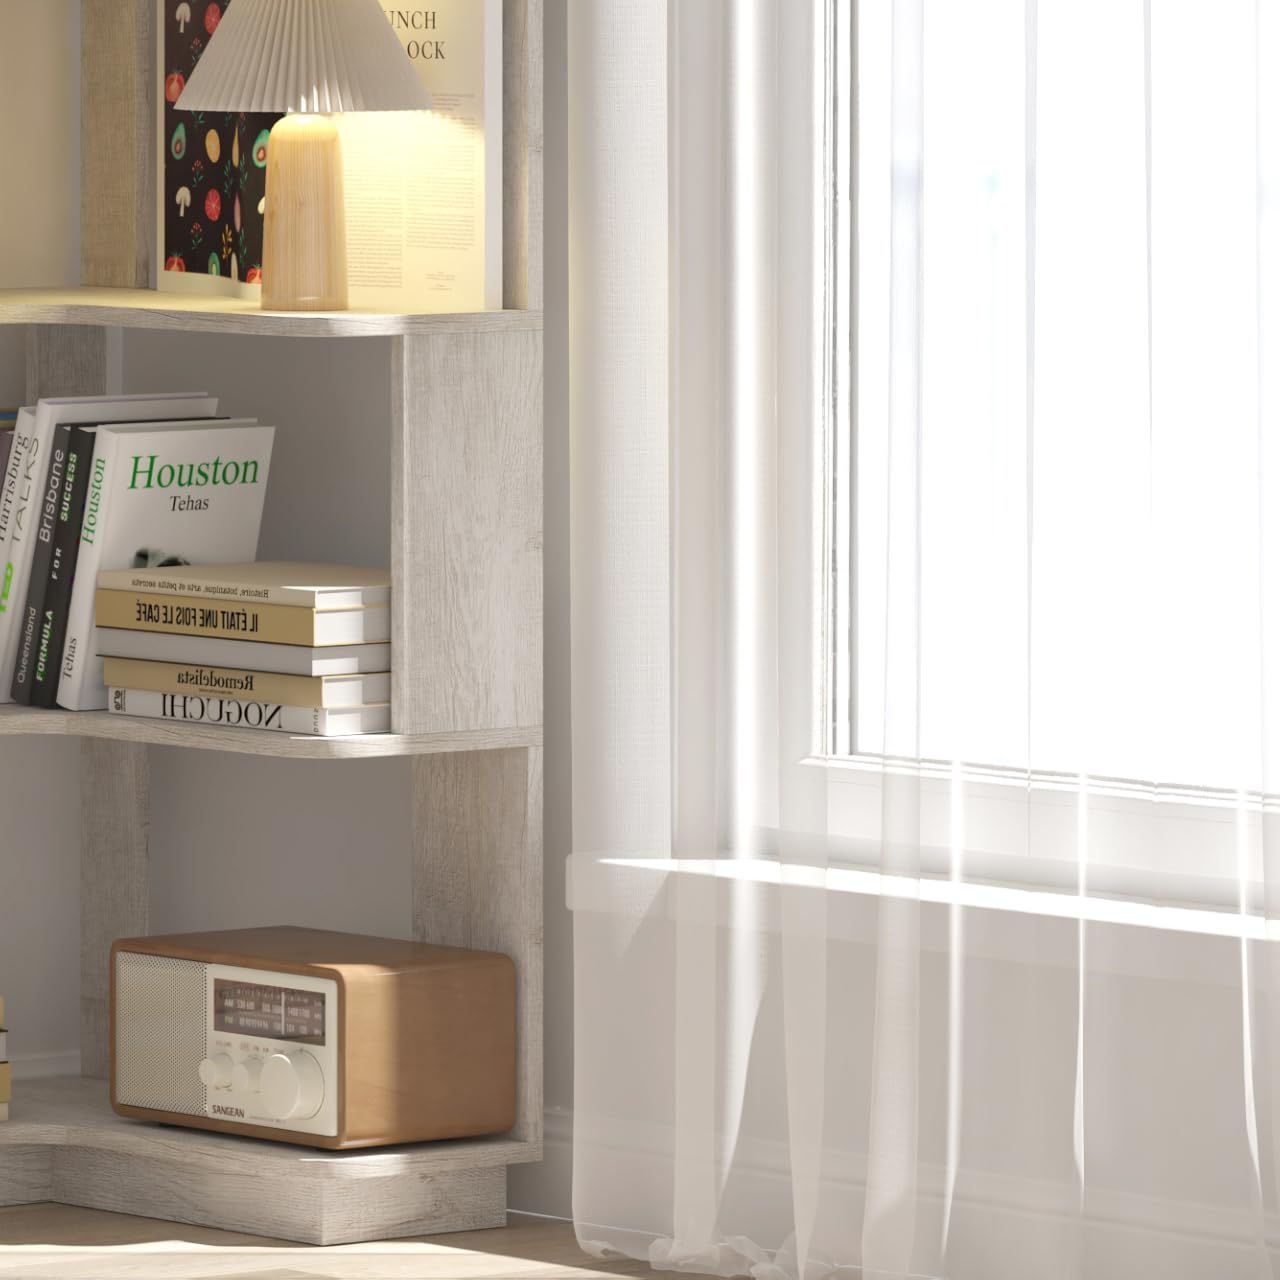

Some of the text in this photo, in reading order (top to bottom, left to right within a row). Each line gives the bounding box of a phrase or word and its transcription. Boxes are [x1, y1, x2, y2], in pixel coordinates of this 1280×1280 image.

[407, 40, 446, 60] OCK
[39, 449, 64, 543] Brisbane
[81, 458, 106, 545] Houston
[128, 454, 259, 490] Houston
[169, 495, 209, 512] Tehas
[36, 452, 78, 681] FORMULA FOR SUCCESS
[17, 607, 37, 684] Queensland
[62, 637, 78, 679] Tehas
